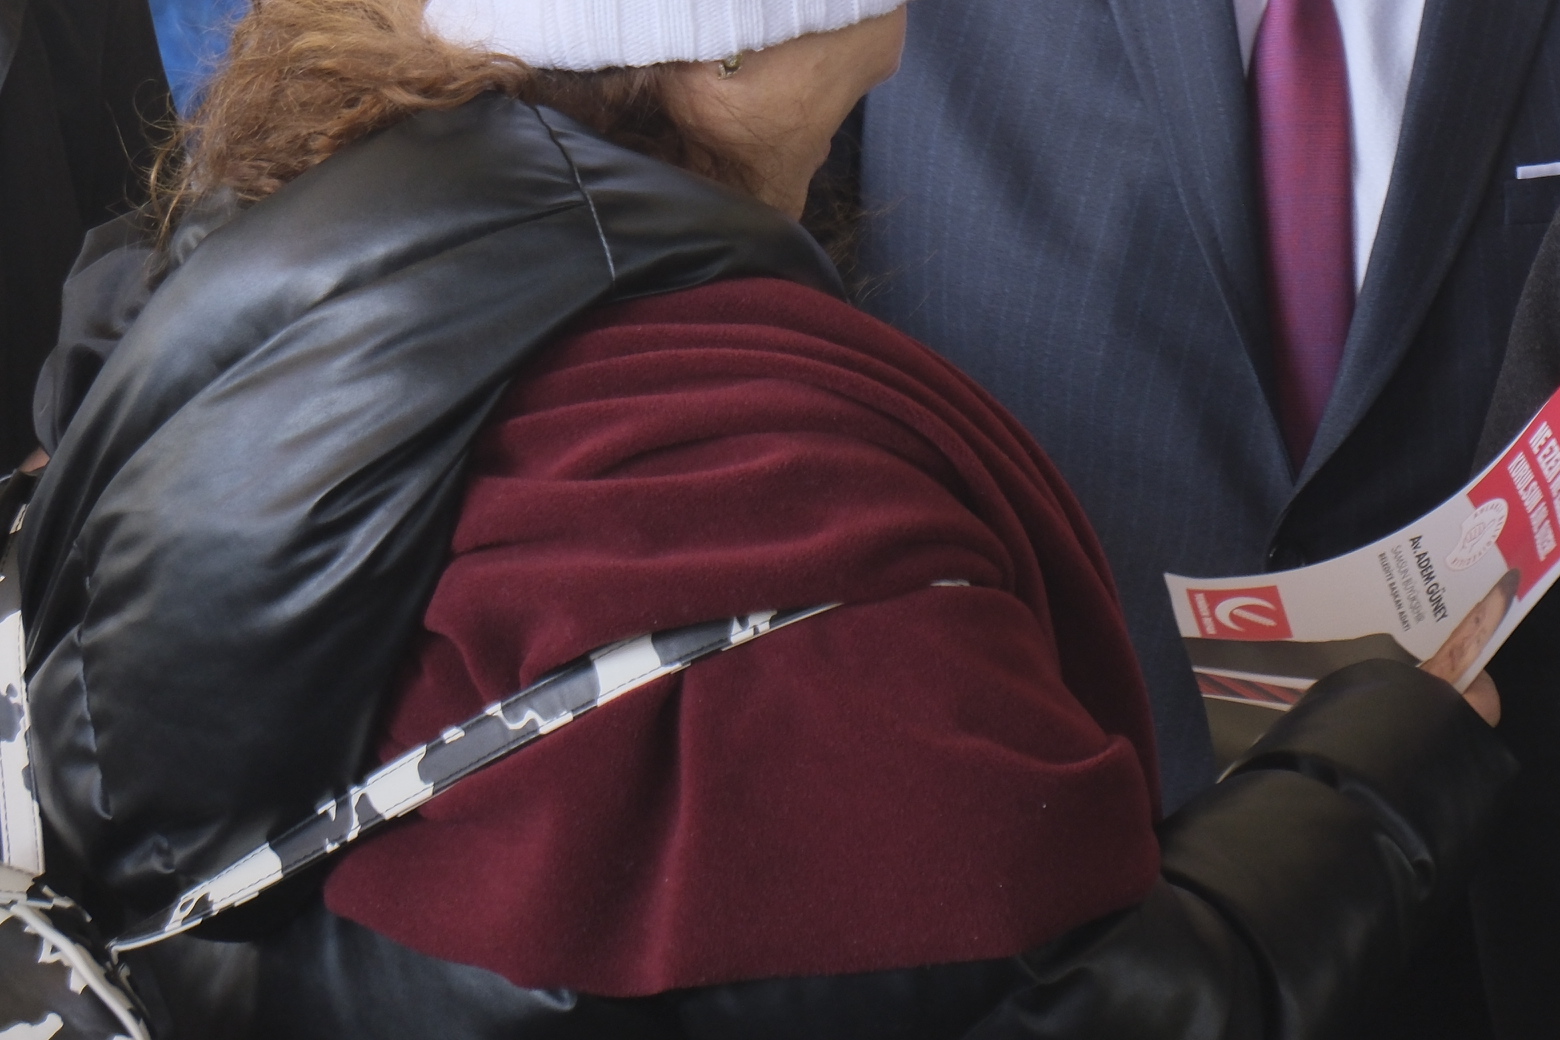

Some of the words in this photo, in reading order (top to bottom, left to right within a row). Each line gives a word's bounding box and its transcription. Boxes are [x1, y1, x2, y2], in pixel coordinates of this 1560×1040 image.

[1507, 451, 1544, 514] KURULSUN
[1409, 534, 1423, 554] Av.
[1415, 551, 1437, 587] ADEM
[1388, 581, 1404, 611] BAŞKAN
[1397, 608, 1412, 632] ADAYI
[1426, 582, 1449, 623] GÜNEY
